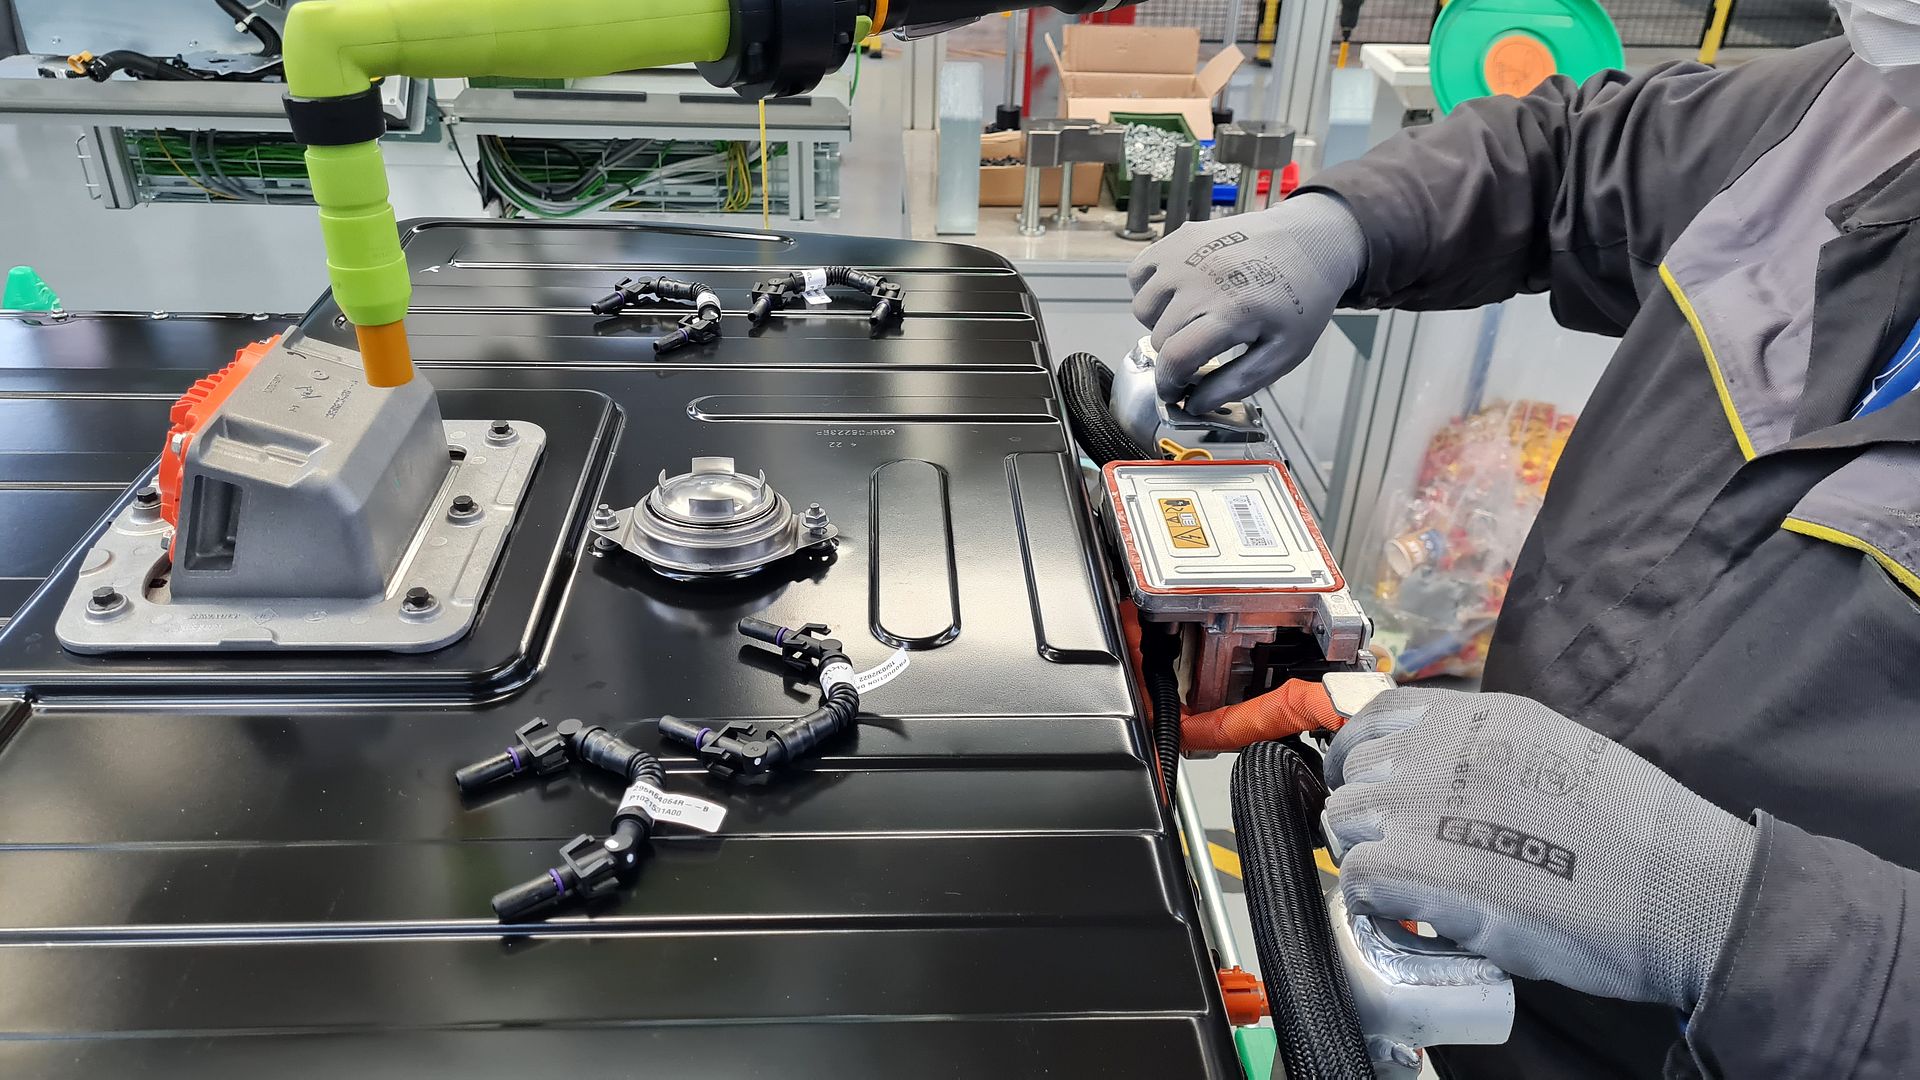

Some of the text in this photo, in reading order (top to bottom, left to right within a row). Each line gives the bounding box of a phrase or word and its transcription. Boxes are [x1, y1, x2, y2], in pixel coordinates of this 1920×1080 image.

[1188, 233, 1245, 266] ERGOS
[859, 661, 896, 682] 15/03/2022
[868, 659, 907, 685] PRODUCTION
[1440, 818, 1574, 878] ERGOS
